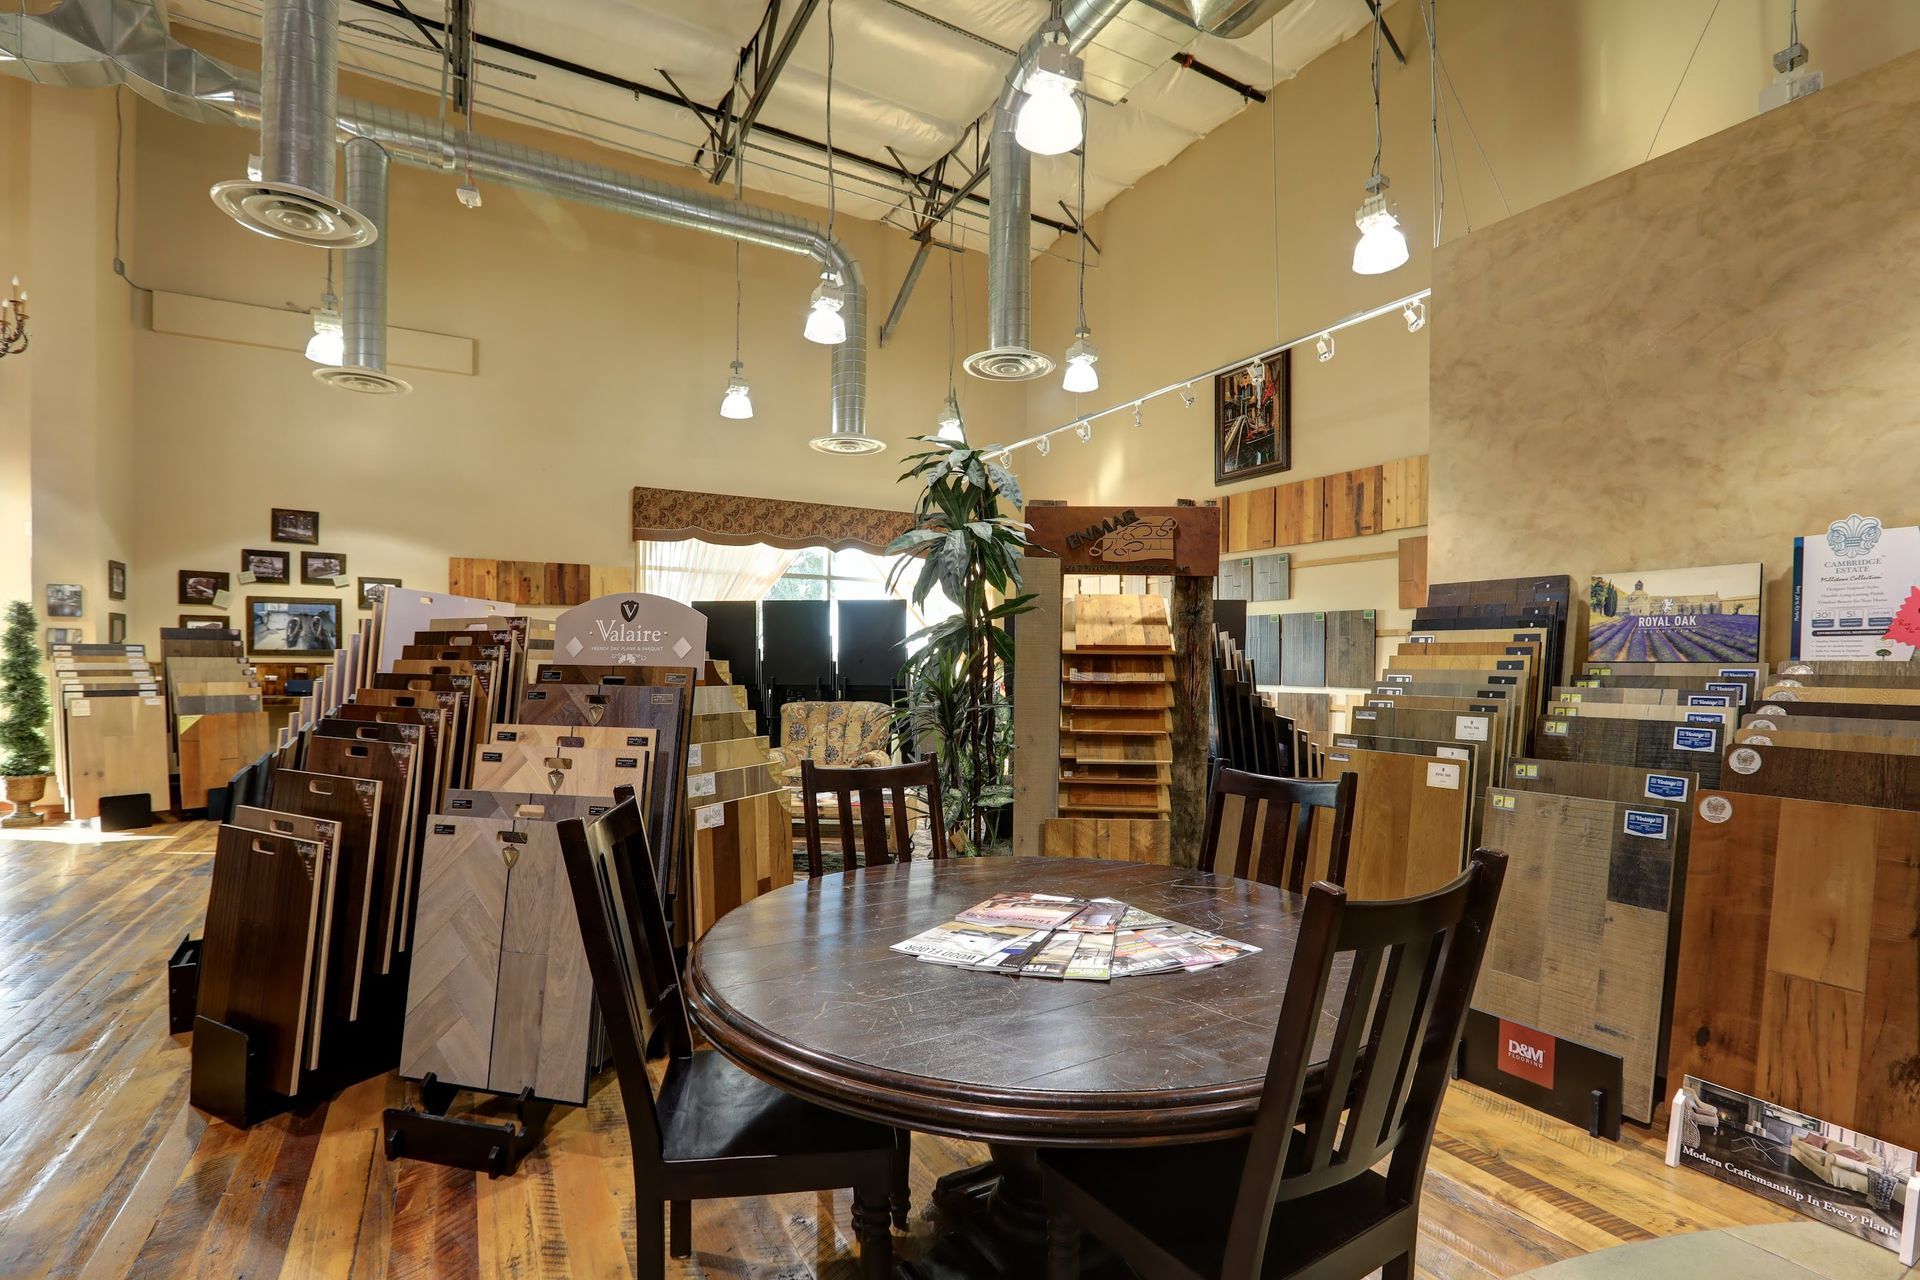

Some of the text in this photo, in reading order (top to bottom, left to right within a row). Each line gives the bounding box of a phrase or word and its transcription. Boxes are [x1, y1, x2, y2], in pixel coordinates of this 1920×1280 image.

[1066, 508, 1141, 549] ENMAR
[1824, 558, 1882, 568] CAMBRIDGE
[1835, 566, 1869, 574] ESTATE
[1638, 615, 1697, 628] ROYAL OAK
[596, 619, 662, 642] Valaire
[1657, 778, 1677, 786] Vintage
[1635, 815, 1656, 824] Vintage
[904, 944, 976, 961] WOOD FLOOR
[1508, 1039, 1544, 1064] D&M
[1508, 1052, 1543, 1069] FLOORING
[1682, 1145, 1898, 1239] Modern Craftsmanship In Every Plank
